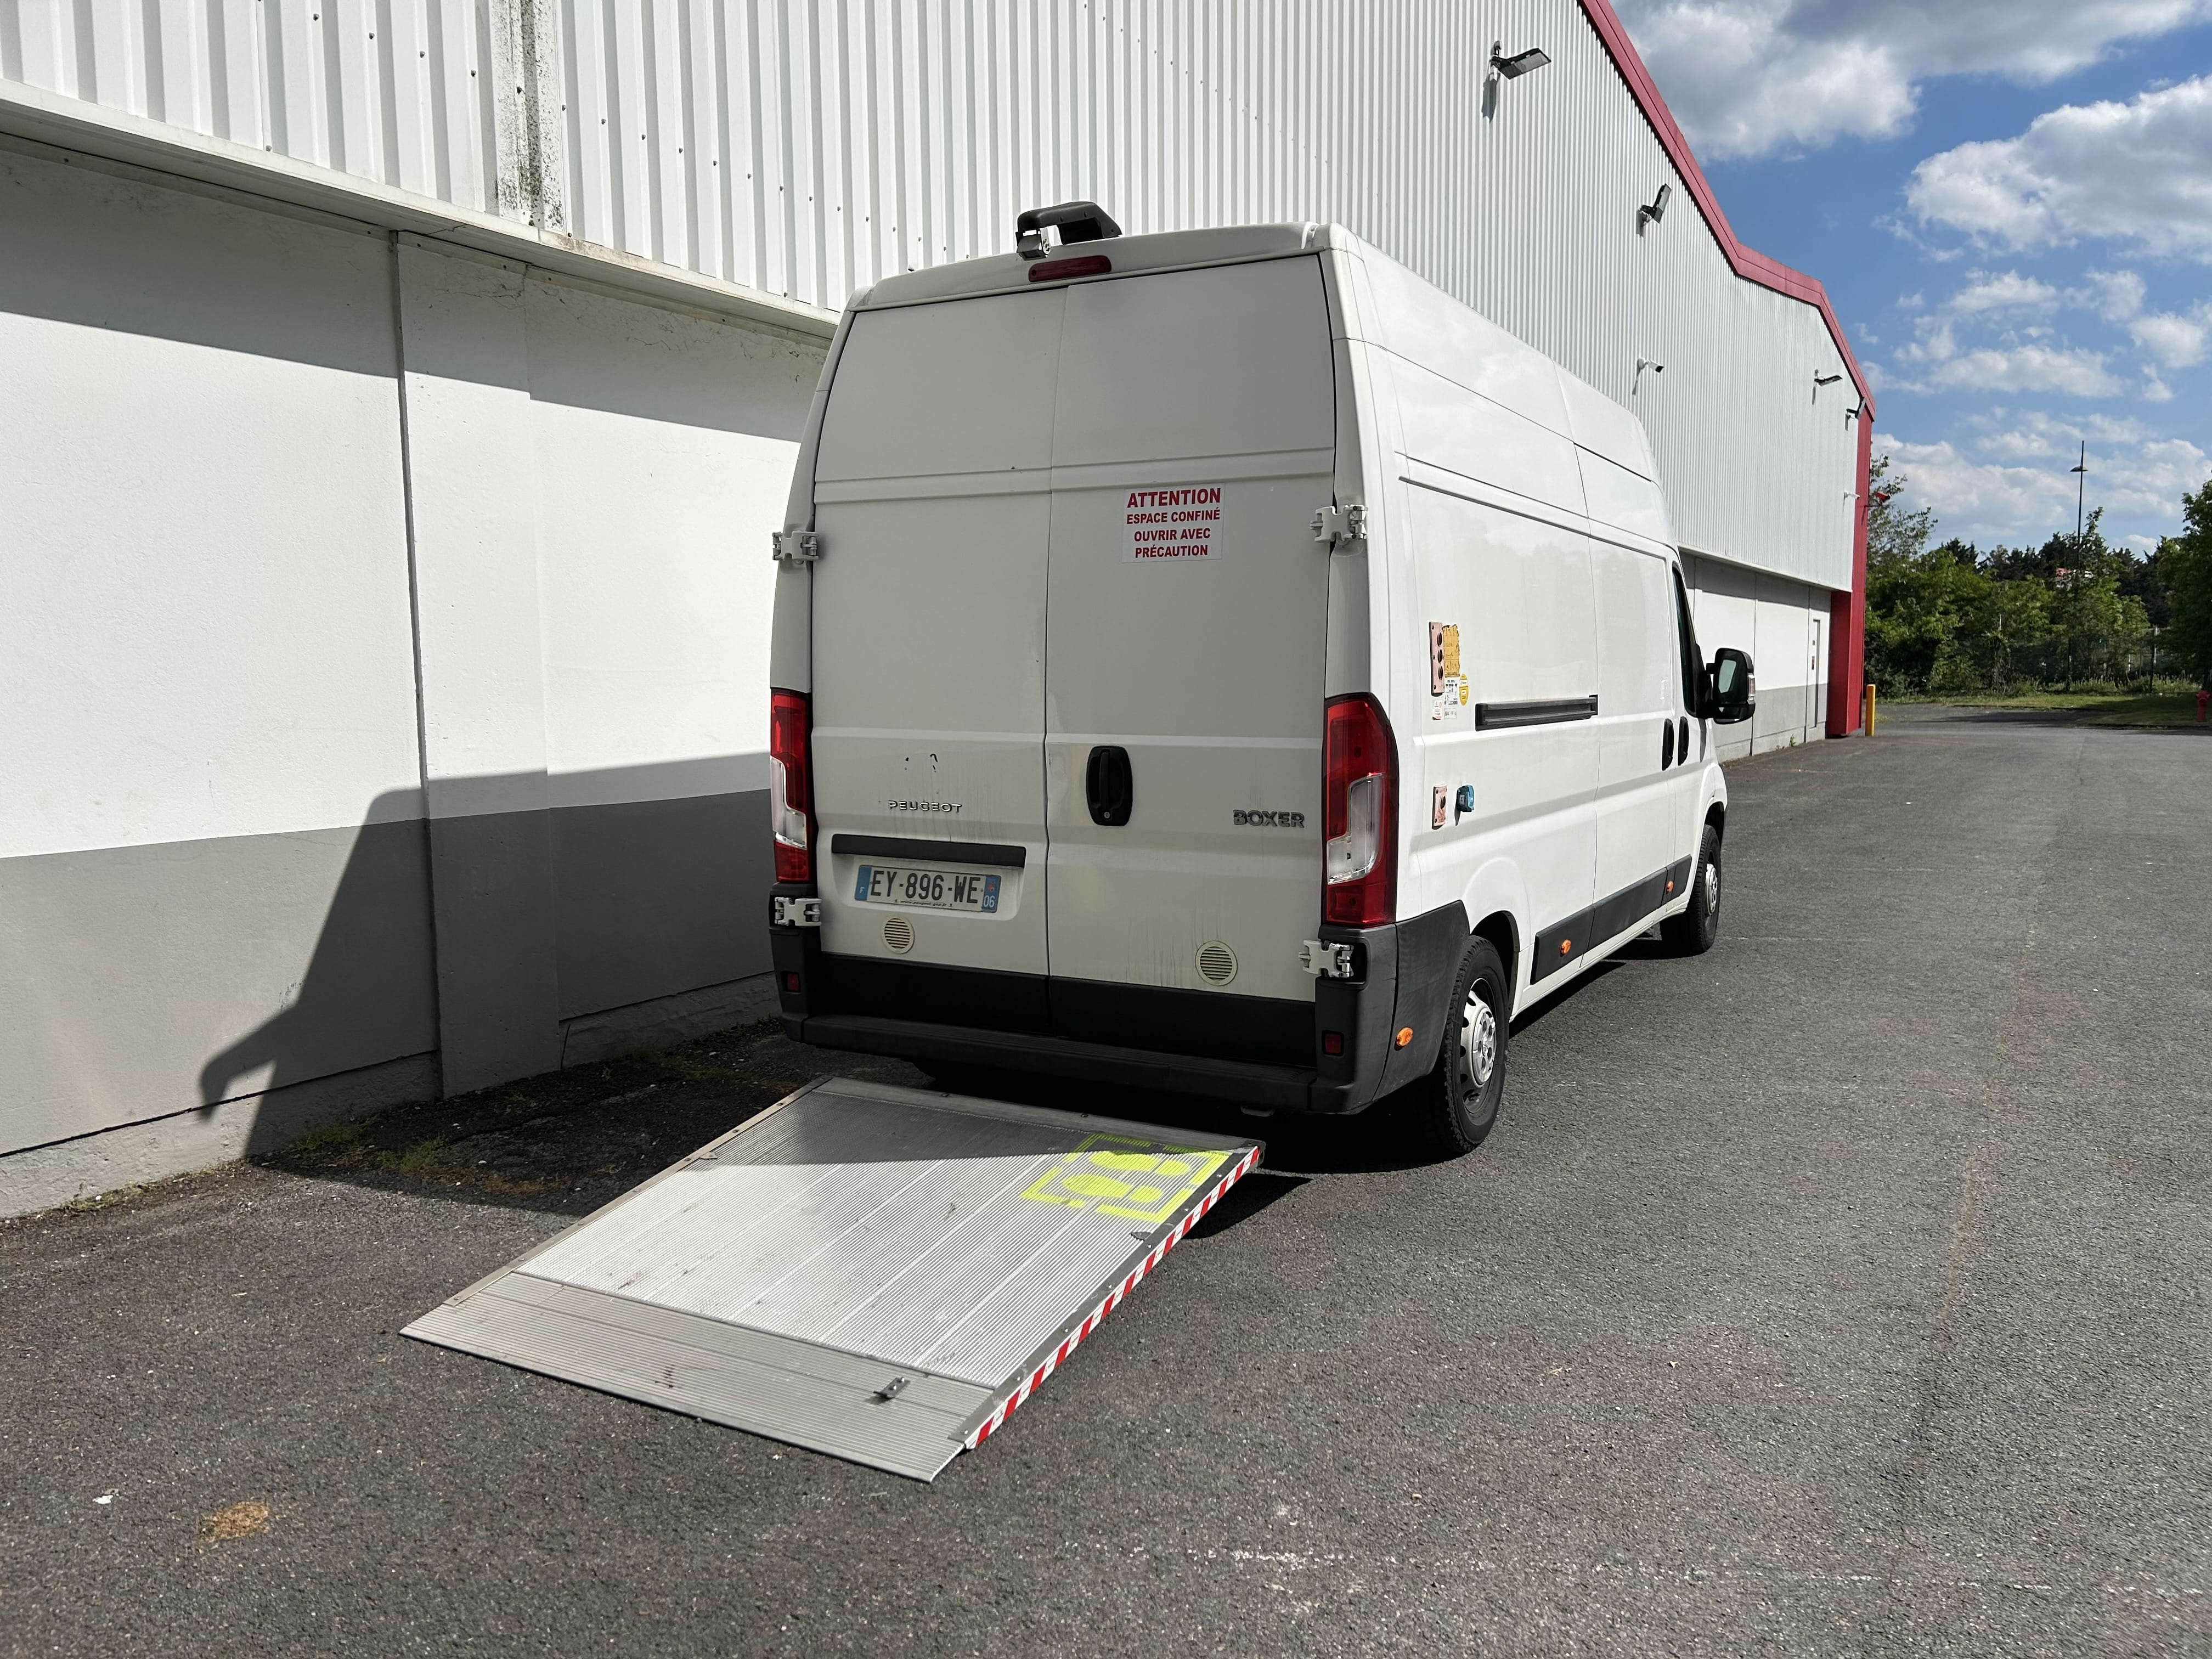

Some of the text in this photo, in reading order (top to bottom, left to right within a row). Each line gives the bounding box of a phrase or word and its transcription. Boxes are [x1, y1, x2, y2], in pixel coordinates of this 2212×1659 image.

[1127, 488, 1221, 508] ATTENTION
[1127, 507, 1220, 524] ESPACE CONFINÉ
[1134, 528, 1211, 541] OUVRIR AVEC
[1135, 544, 1208, 558] PRÉCAUTION
[888, 800, 962, 812] PEUGEOT
[1233, 809, 1305, 828] BOXER
[871, 870, 981, 904] EY-896-WE
[983, 895, 995, 907] 06
